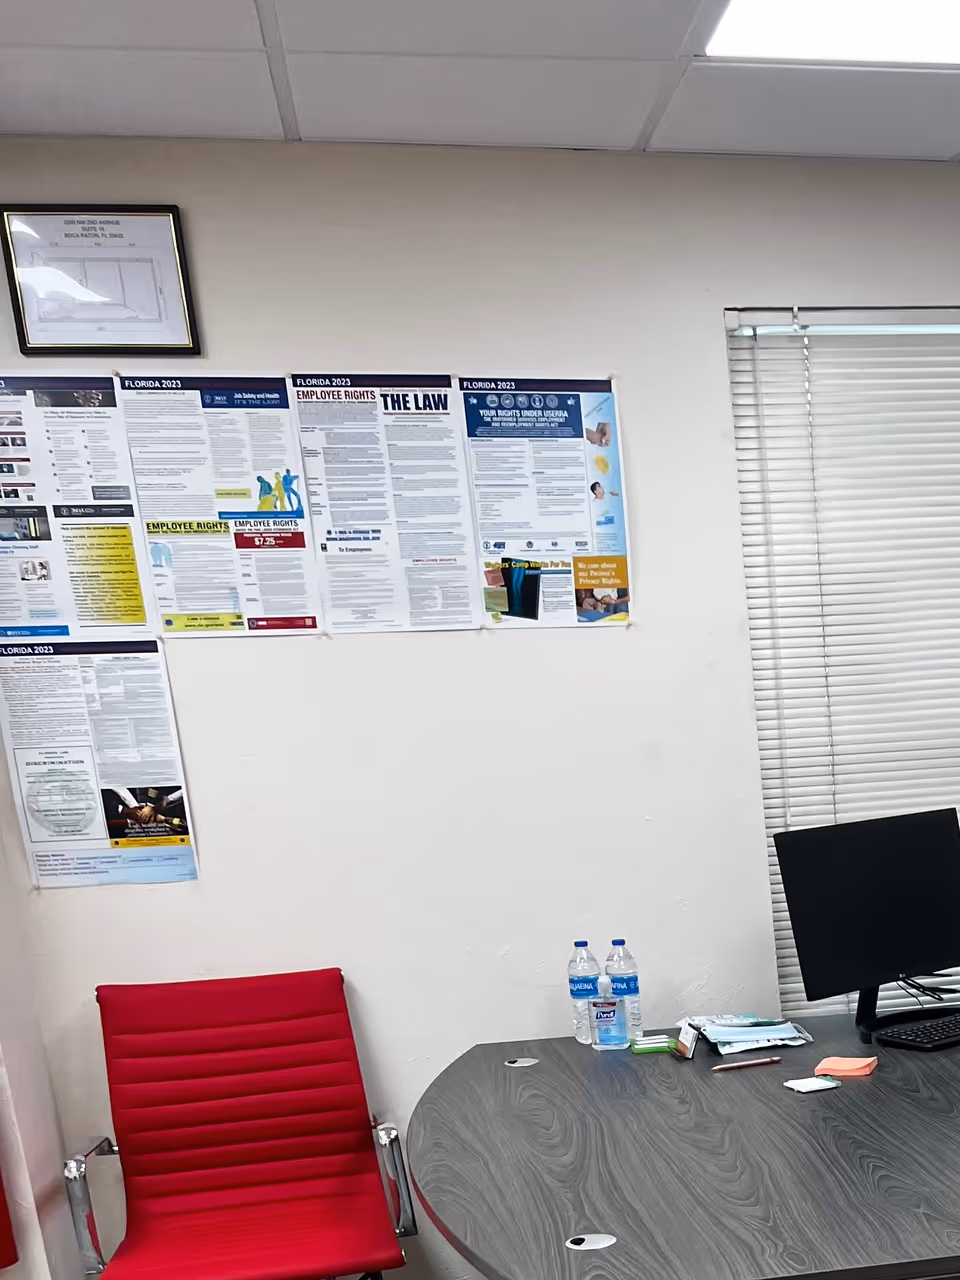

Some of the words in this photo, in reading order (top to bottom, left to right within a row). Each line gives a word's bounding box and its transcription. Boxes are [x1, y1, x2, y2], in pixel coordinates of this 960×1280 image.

[124, 380, 162, 388] FLORIDA
[161, 380, 182, 388] 2023
[296, 378, 331, 386] FLORIDA
[332, 378, 351, 386] 2023
[463, 381, 497, 389] FLORIDA
[497, 382, 516, 390] 2023
[296, 390, 343, 400] EMPLOYEE
[344, 390, 376, 400] RIGHTS
[380, 393, 411, 411] THE
[413, 393, 449, 411] LAW
[146, 522, 195, 530] EMPLOYEE
[196, 522, 230, 530] RIGHTS
[254, 537, 276, 546] $7.25
[511, 561, 530, 569] Comp
[0, 647, 33, 655] FLORIDA
[34, 646, 54, 654] 2023
